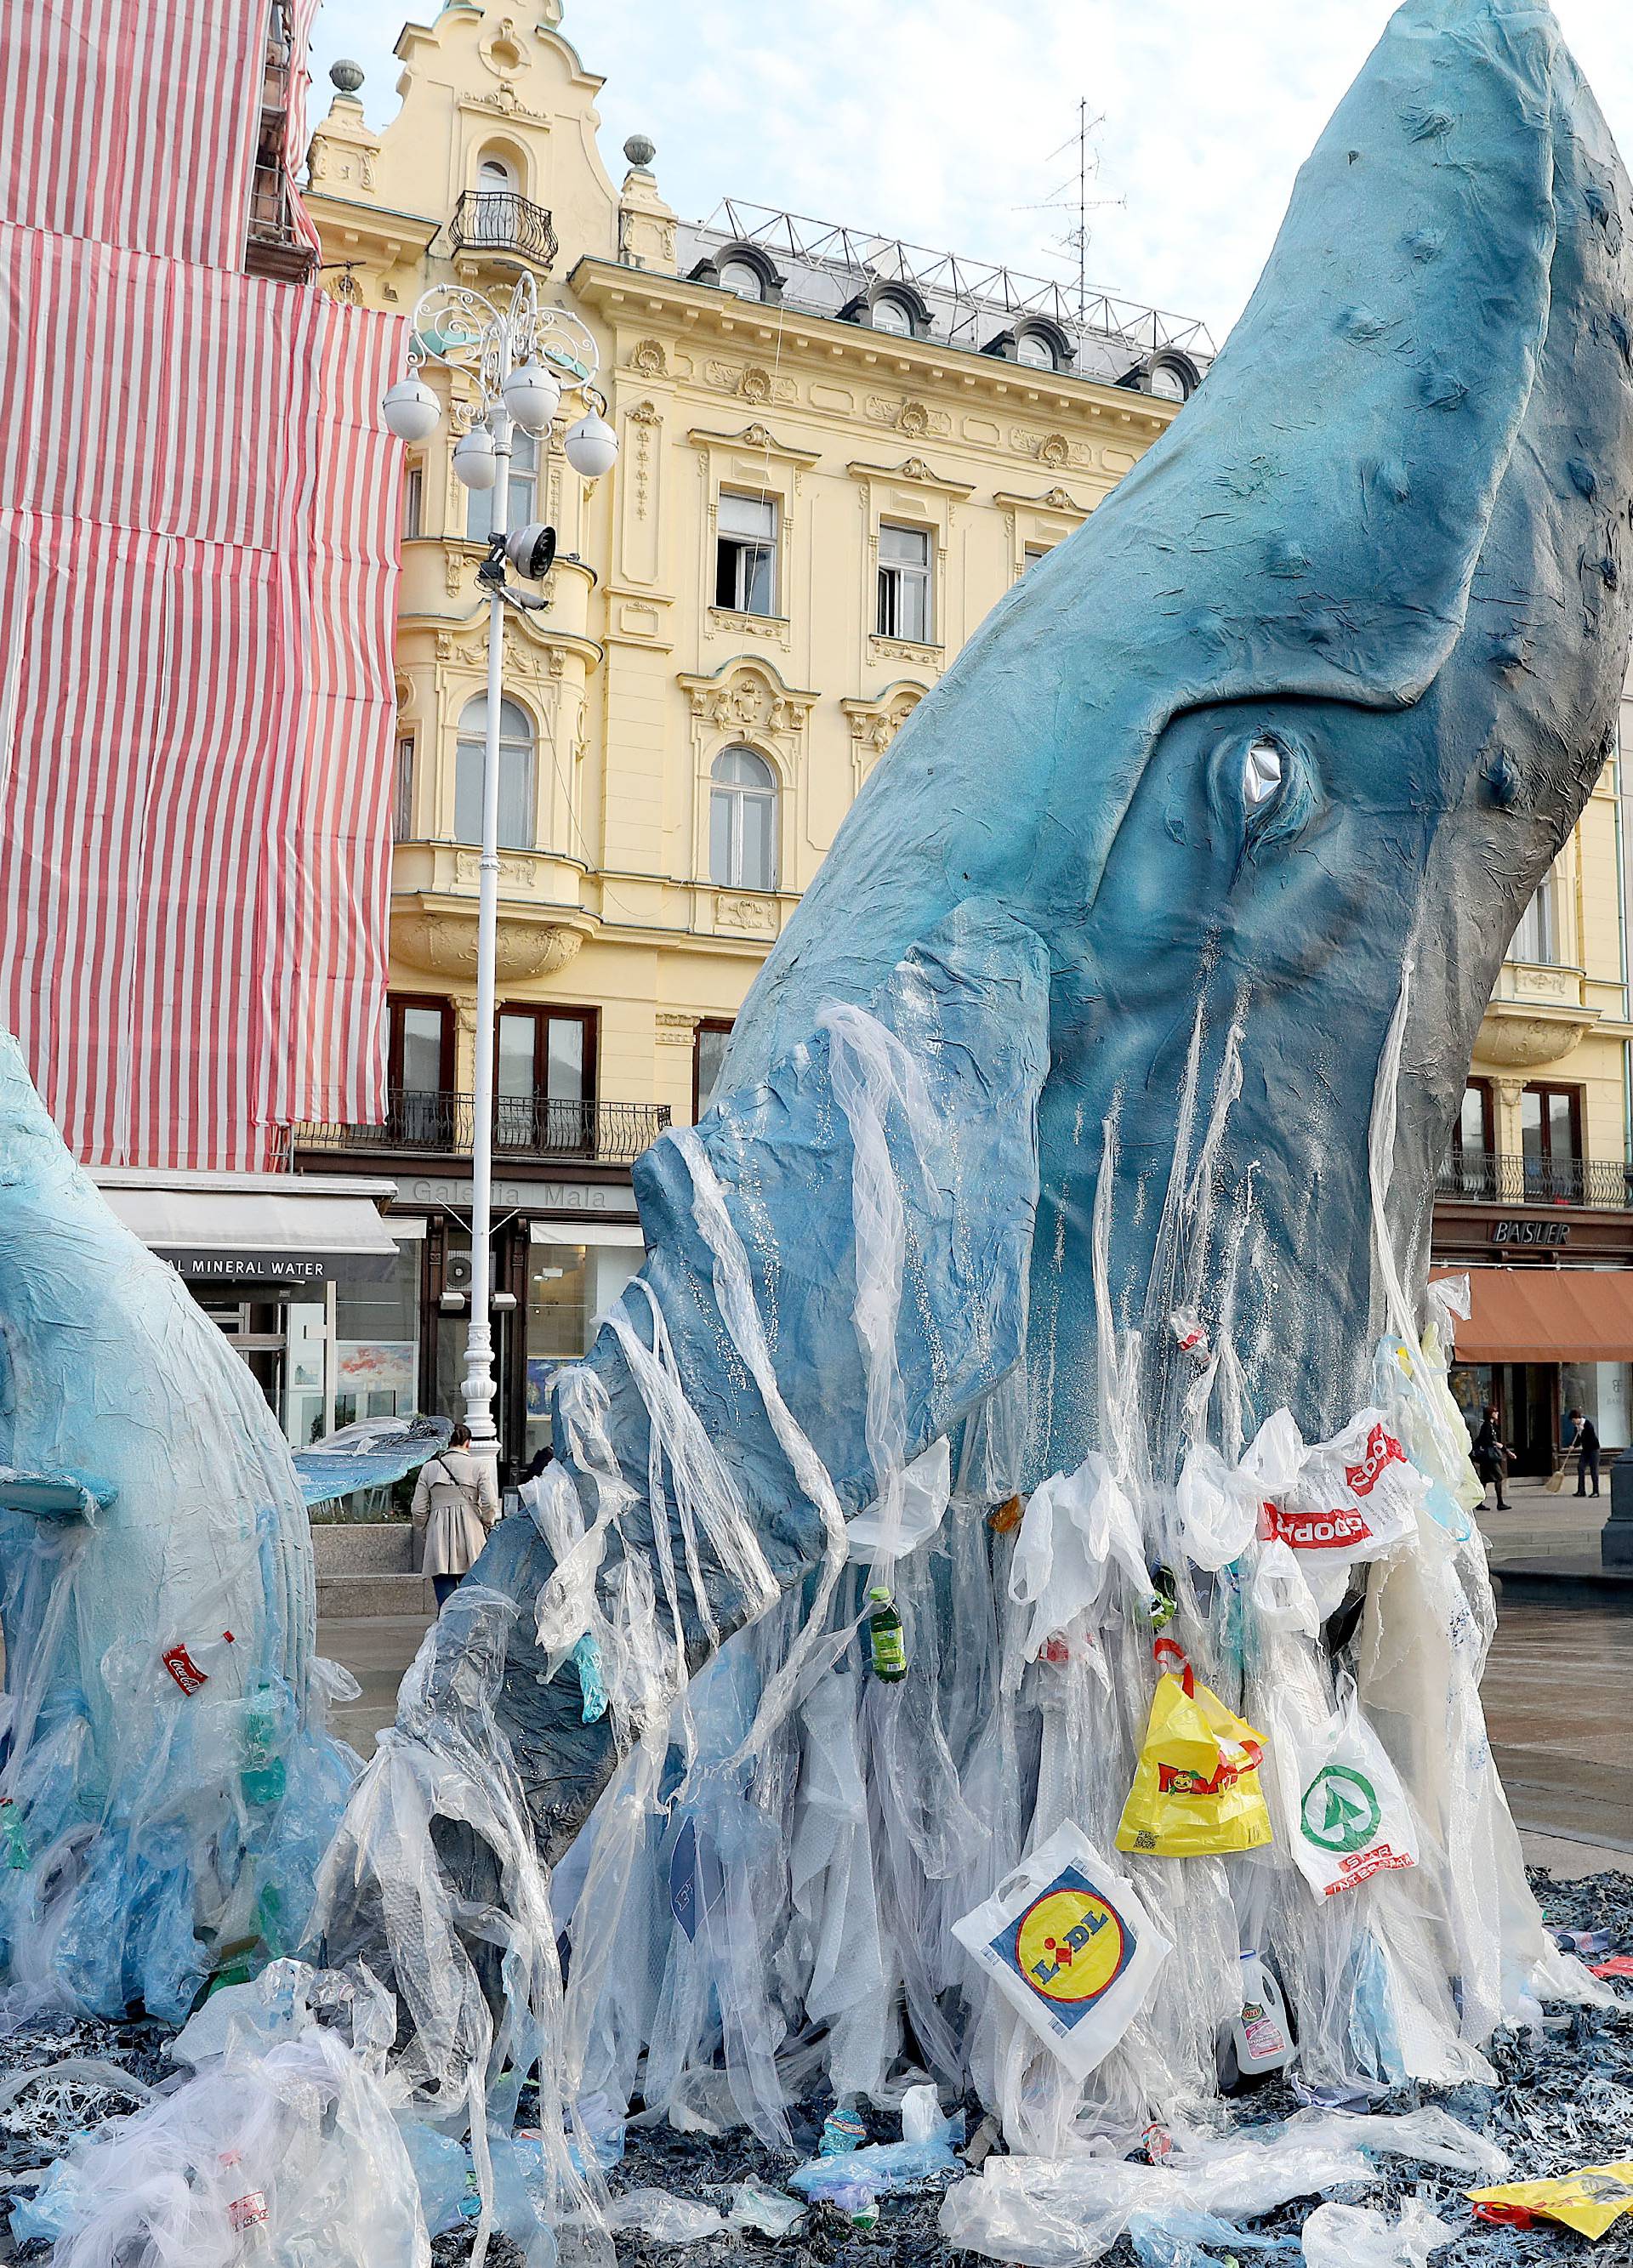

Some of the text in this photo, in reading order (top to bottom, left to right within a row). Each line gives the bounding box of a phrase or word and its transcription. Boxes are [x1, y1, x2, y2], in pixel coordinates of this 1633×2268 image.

[413, 1180, 606, 1208] Galeija Mala
[1494, 1221, 1571, 1244] BASLER
[168, 1259, 324, 1276] AL MINERAL WATER
